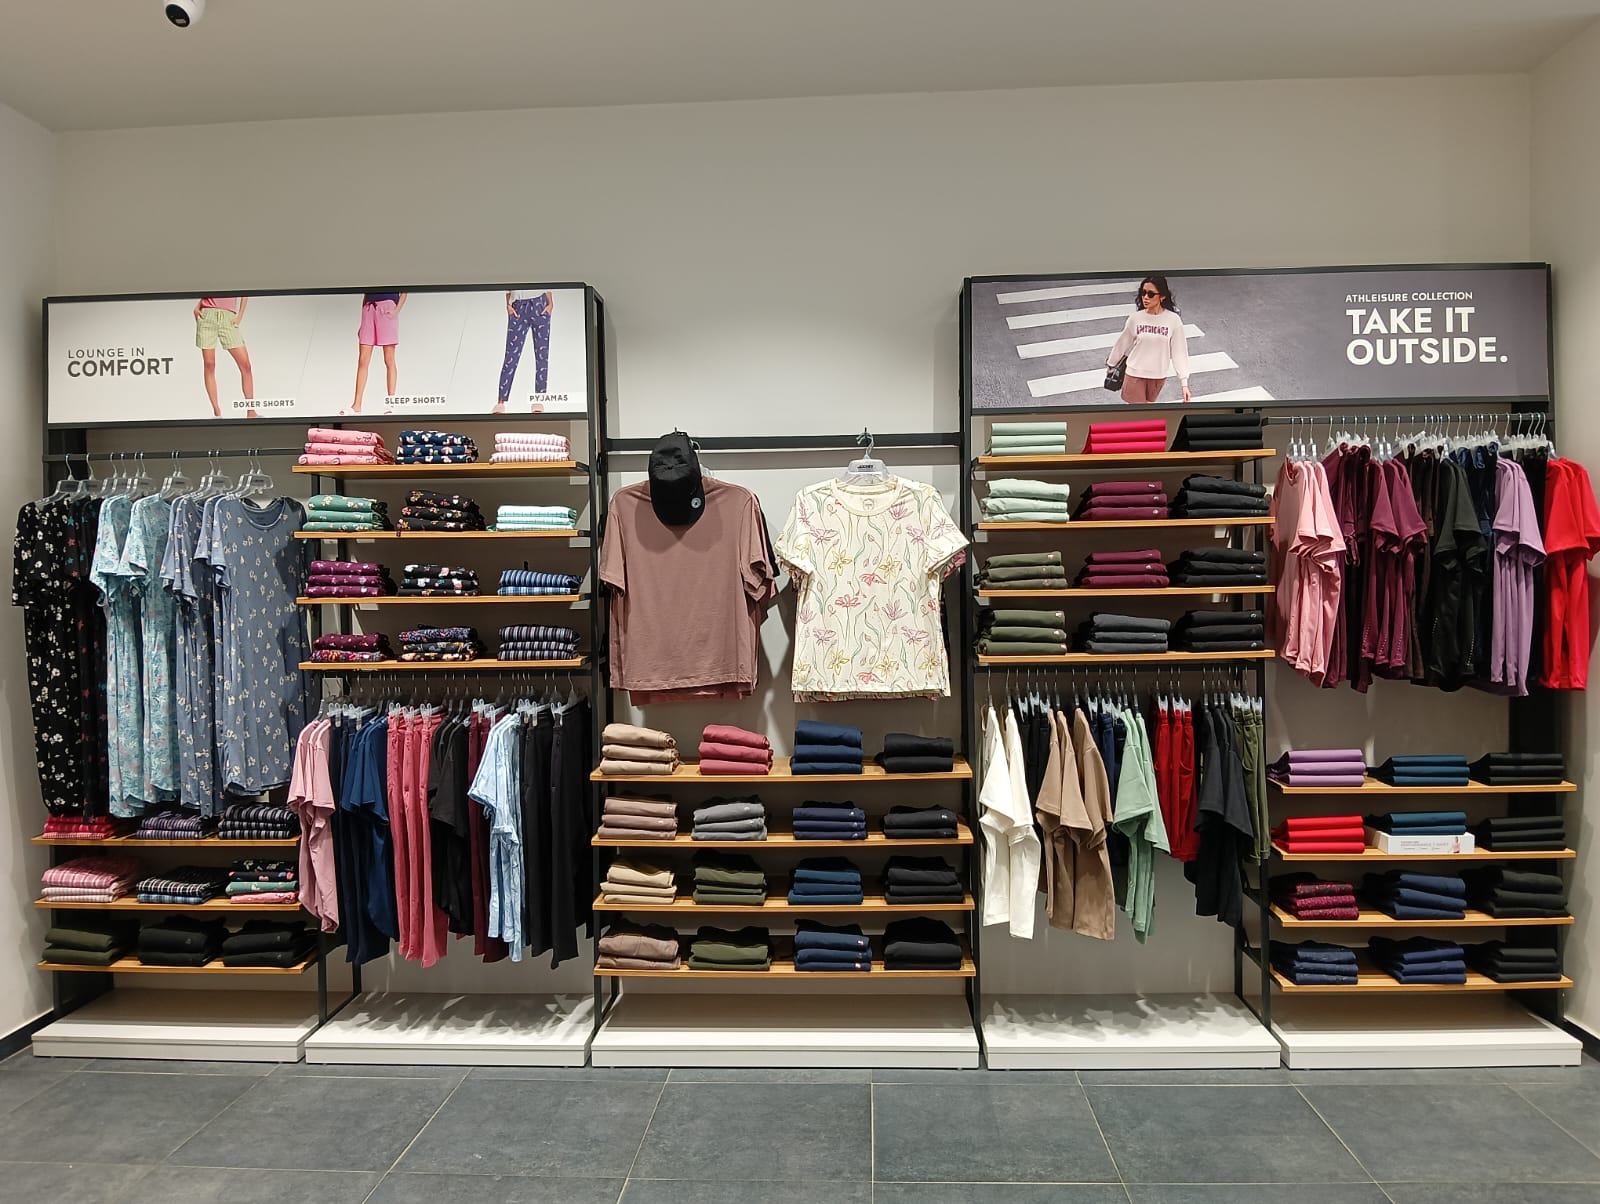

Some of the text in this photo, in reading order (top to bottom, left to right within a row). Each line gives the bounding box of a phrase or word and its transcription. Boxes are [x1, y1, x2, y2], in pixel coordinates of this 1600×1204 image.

[1345, 292, 1473, 302] ATHLEISURE COLLECTION
[1346, 307, 1476, 335] TAKE IT
[68, 347, 144, 359] LOUNGE IN
[1346, 336, 1508, 366] OUTSIDE.
[67, 357, 174, 378] COMFORT
[263, 399, 295, 407] SHORTS
[412, 396, 446, 404] SHORTS
[529, 394, 568, 402] PYJAMAS
